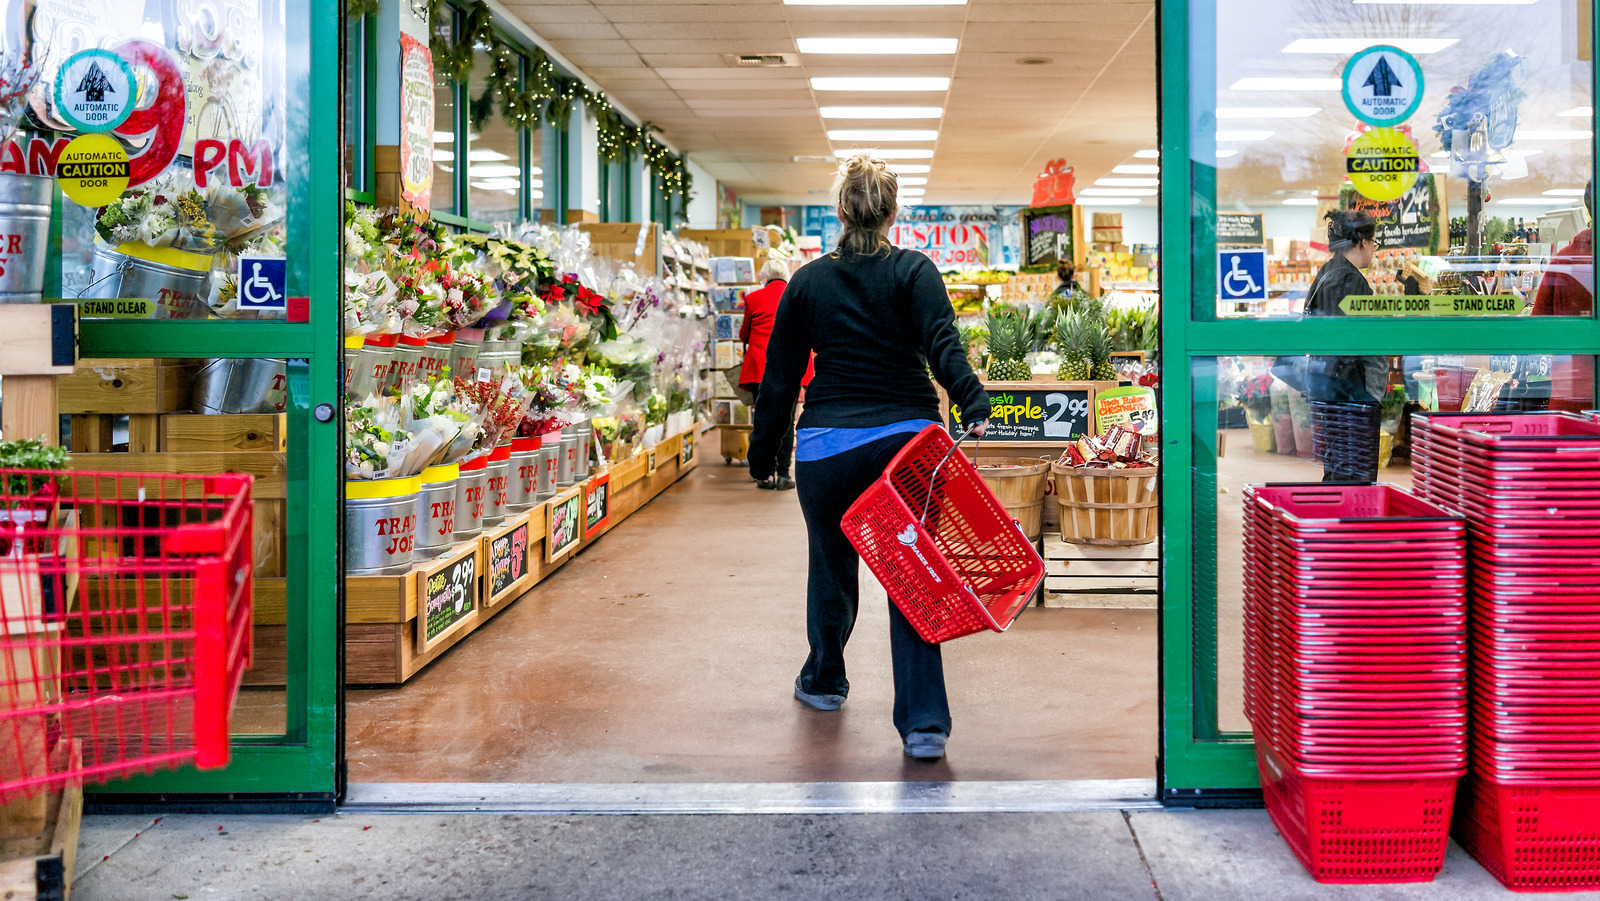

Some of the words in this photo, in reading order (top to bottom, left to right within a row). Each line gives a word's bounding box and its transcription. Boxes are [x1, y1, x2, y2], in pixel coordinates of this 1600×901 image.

[1361, 98, 1407, 106] AUTOMATIC
[74, 103, 119, 112] AUTOMATIC
[1373, 107, 1396, 115] DOOR
[86, 113, 108, 121] DOOR
[1356, 147, 1412, 155] AUTOMATIC
[66, 152, 122, 161] AUTOMATIC
[193, 138, 273, 188] PM
[1352, 158, 1416, 171] CAUTION
[62, 163, 126, 177] CAUTION
[1370, 174, 1398, 182] DOOR
[80, 180, 108, 188] DOOR
[894, 224, 991, 249] ESTON
[945, 249, 982, 263] JOE
[84, 302, 114, 314] STAND
[117, 302, 147, 314] CLEAR
[1350, 299, 1403, 312] AUTOMATIC
[1405, 299, 1430, 311] DOOR
[1453, 299, 1484, 311] STAND
[1487, 299, 1515, 311] CLEAR
[989, 393, 1014, 405] esh
[1100, 398, 1120, 408] Fresh
[998, 430, 1018, 438] Holiday
